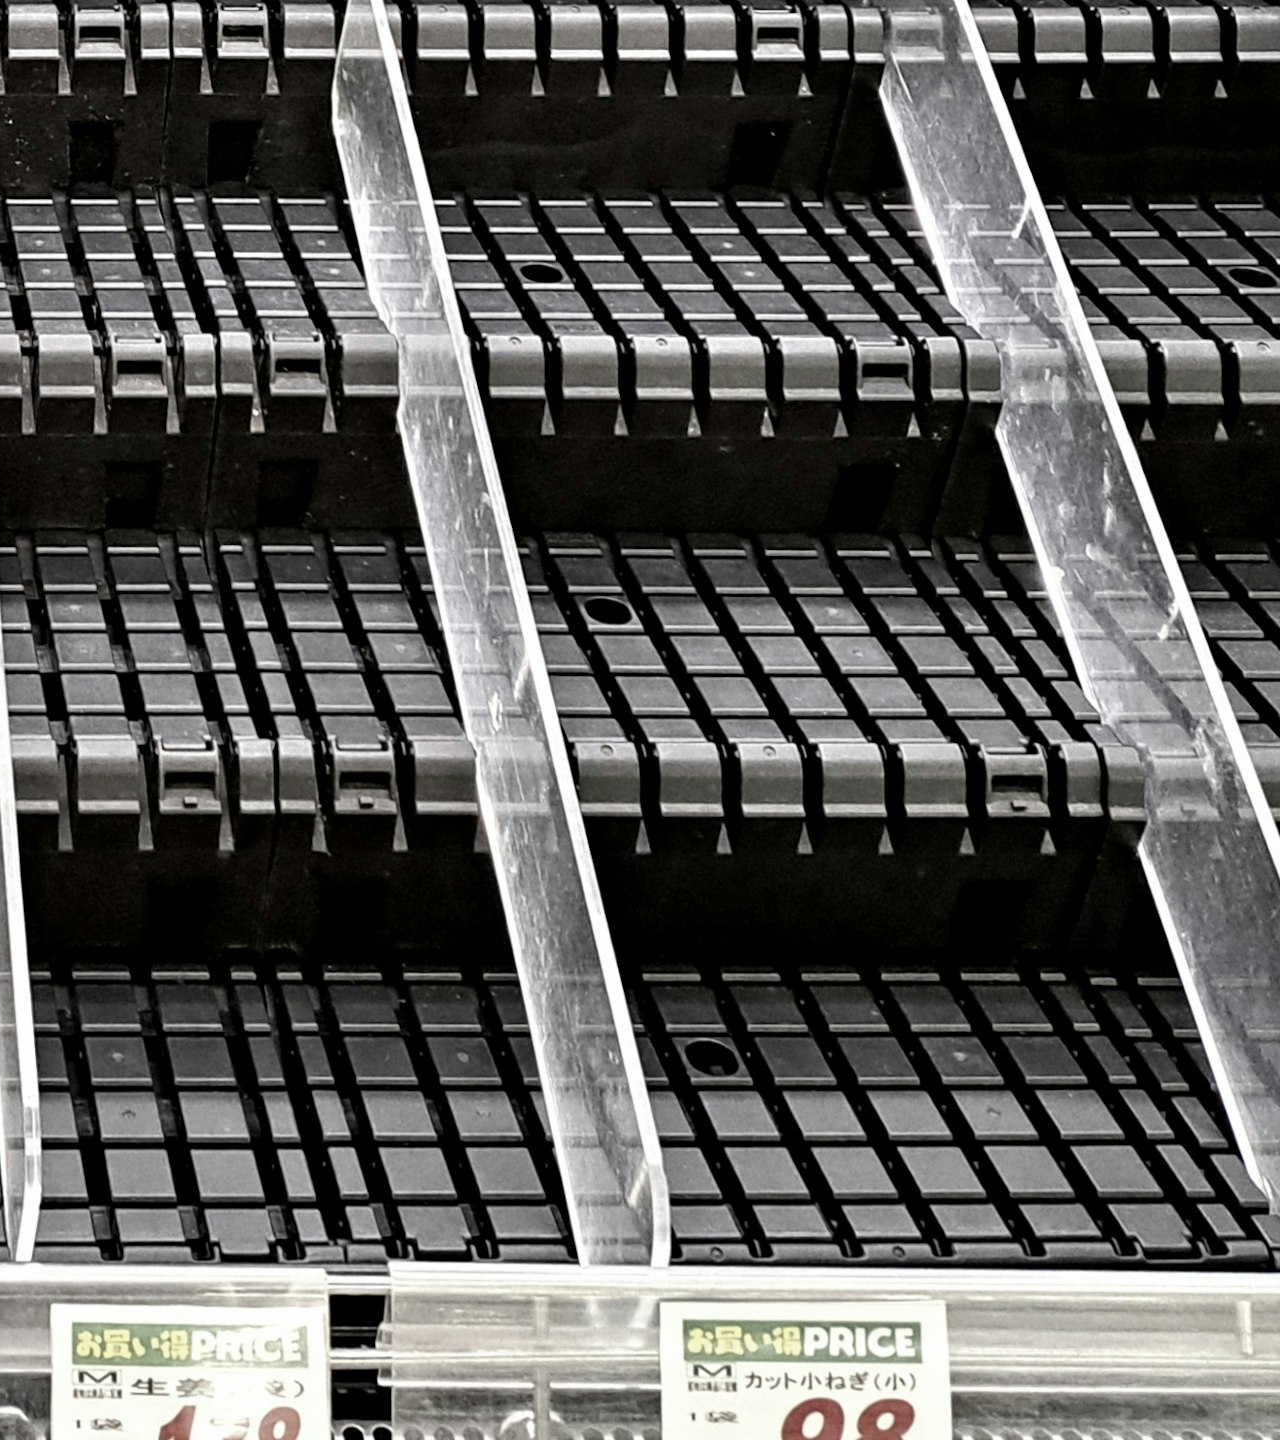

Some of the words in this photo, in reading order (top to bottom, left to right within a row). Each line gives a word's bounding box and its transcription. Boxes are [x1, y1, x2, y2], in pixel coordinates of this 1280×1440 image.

[688, 1325, 916, 1358] お買い得PRICE
[745, 1371, 917, 1391] カット小ねぎ(小)
